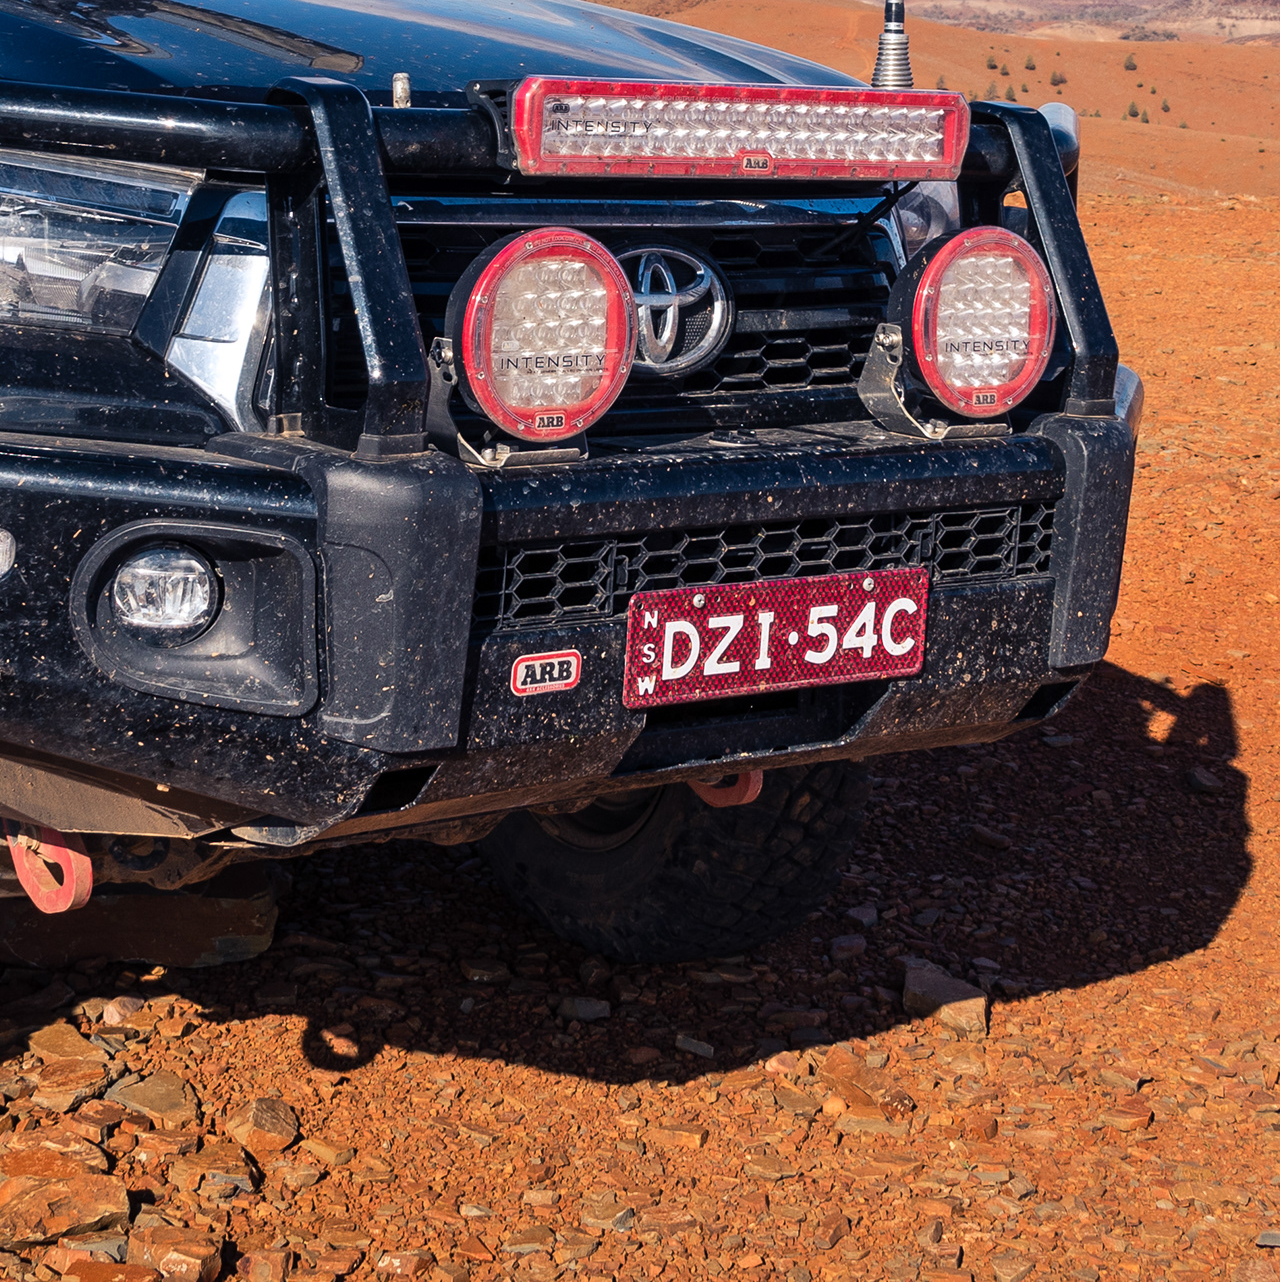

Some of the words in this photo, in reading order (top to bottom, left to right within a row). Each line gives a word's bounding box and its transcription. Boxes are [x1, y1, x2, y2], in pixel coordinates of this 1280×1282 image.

[551, 120, 653, 133] INTENSITY
[744, 158, 768, 169] ARB
[945, 340, 1031, 353] INTENSITY
[500, 355, 606, 370] INTENSITY
[974, 394, 996, 405] ARB
[536, 415, 564, 429] ARB
[521, 659, 572, 686] ARB
